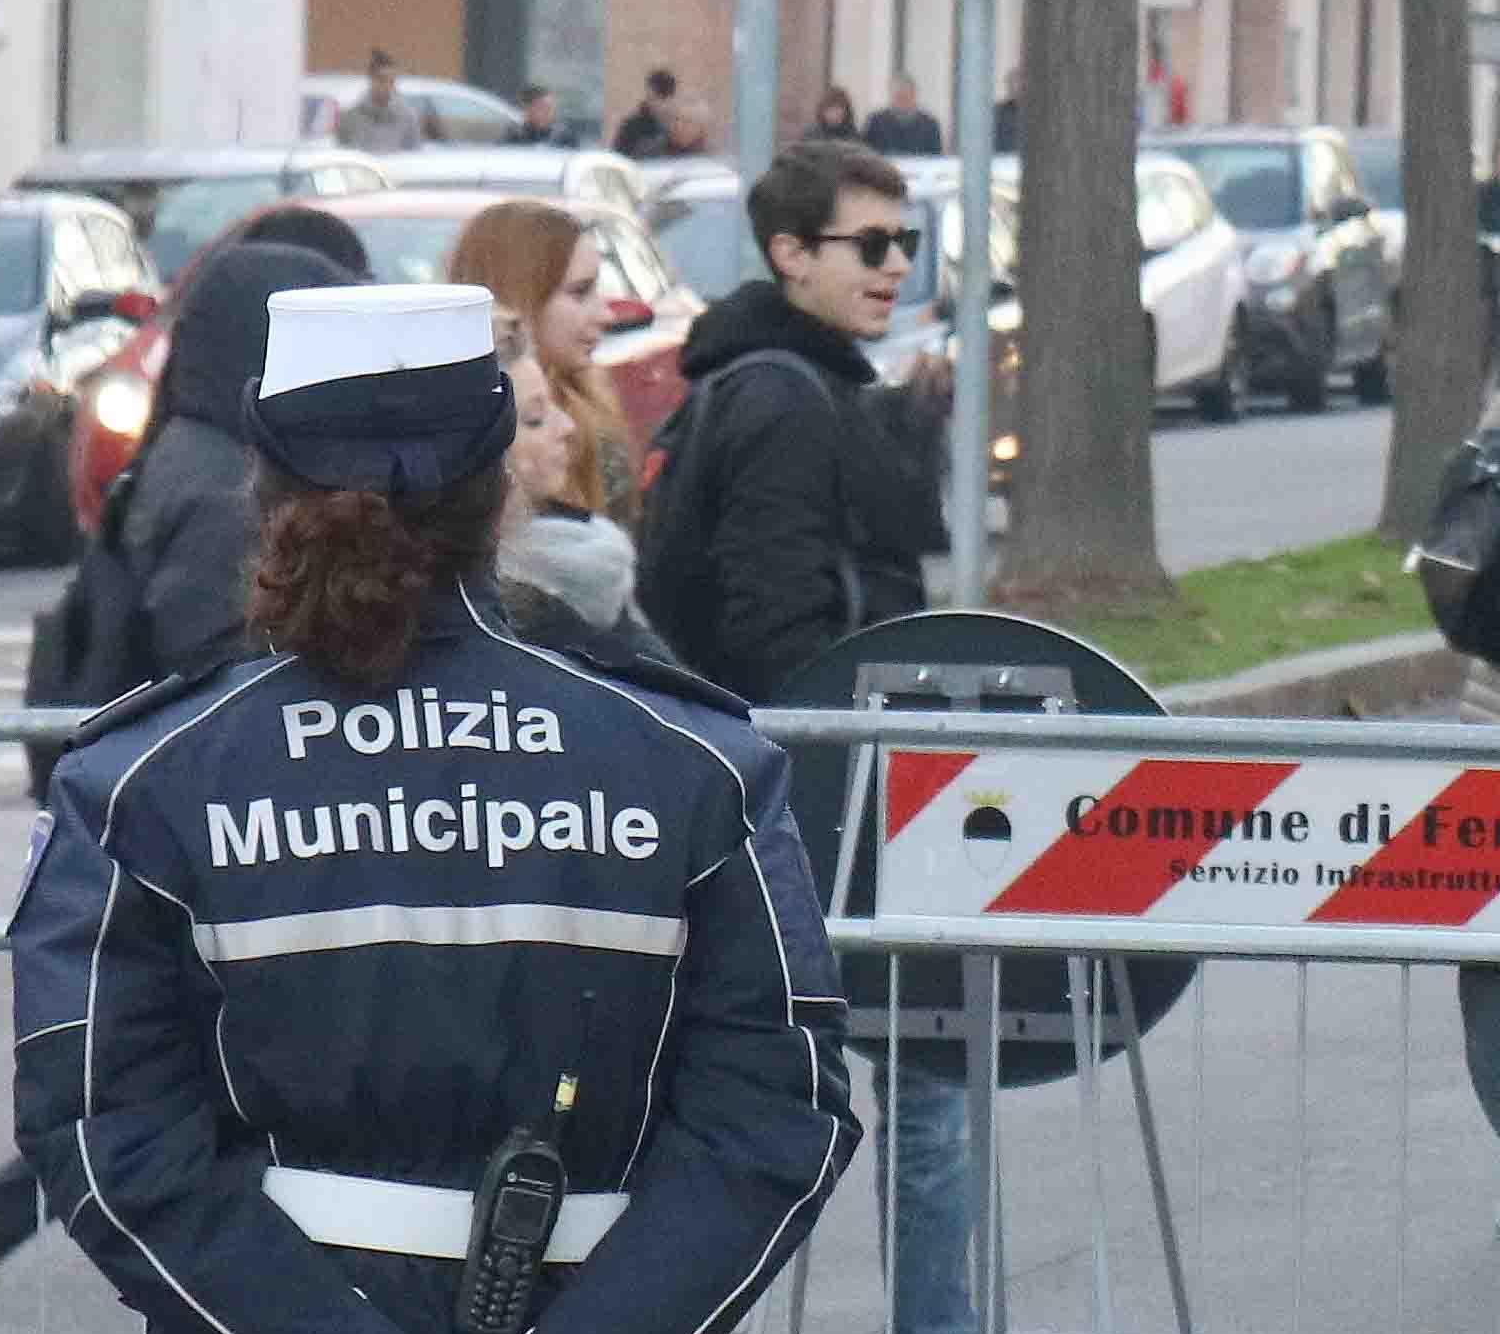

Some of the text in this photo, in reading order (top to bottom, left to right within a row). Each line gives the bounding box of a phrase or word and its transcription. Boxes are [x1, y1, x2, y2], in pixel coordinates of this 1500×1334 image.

[281, 686, 565, 760] Polizia
[205, 783, 661, 868] Municipale
[1065, 794, 1311, 843] Comune
[1339, 802, 1393, 845] di
[1169, 859, 1301, 886] Servizio
